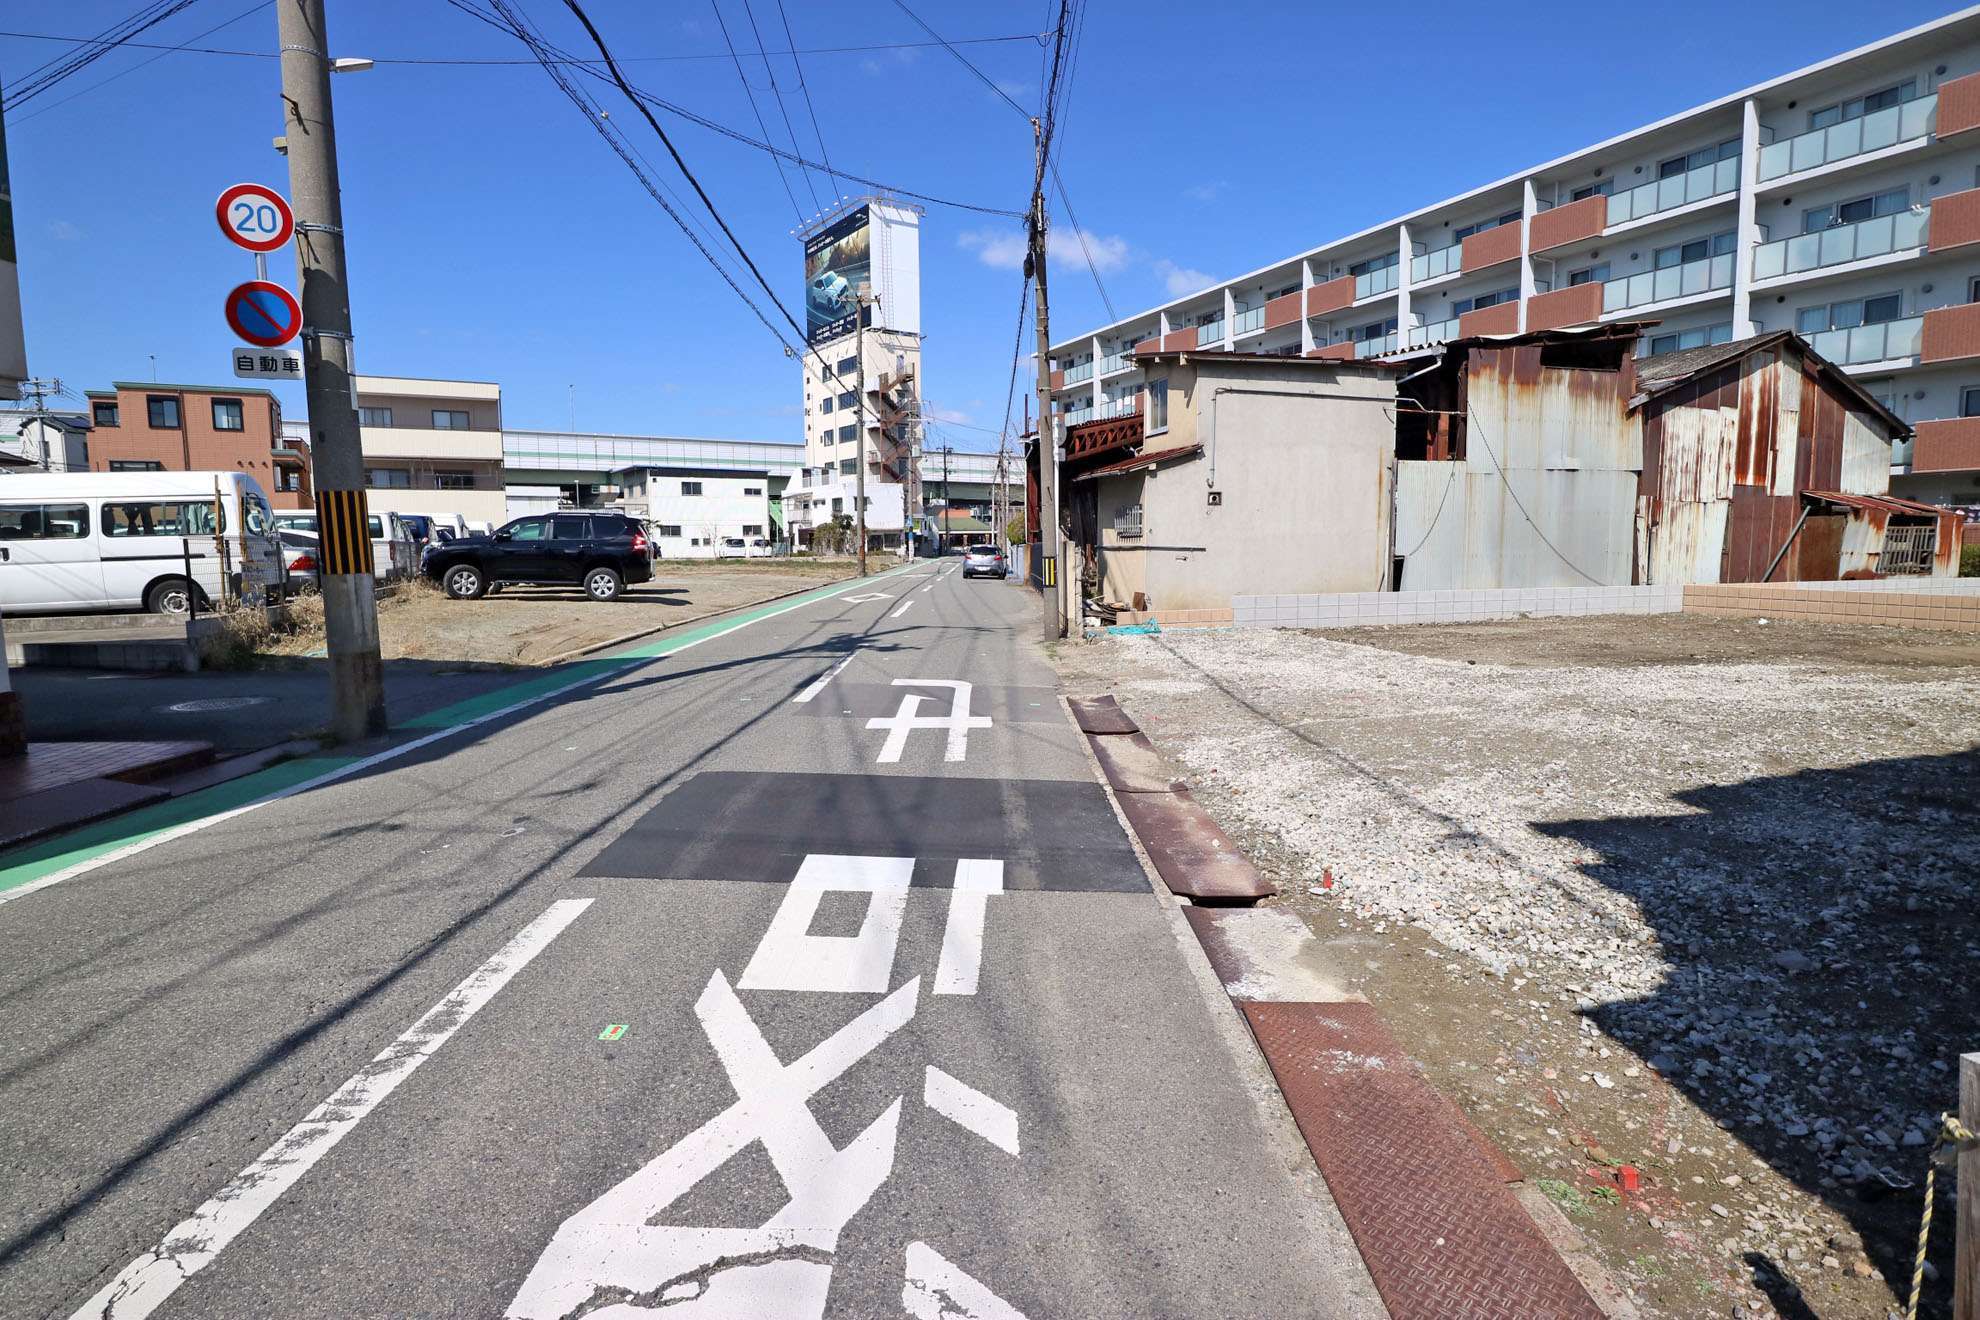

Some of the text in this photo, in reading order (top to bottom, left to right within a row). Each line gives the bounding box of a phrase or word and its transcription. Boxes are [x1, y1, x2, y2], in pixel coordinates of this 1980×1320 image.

[234, 202, 277, 233] 20
[237, 355, 300, 373] 自動車
